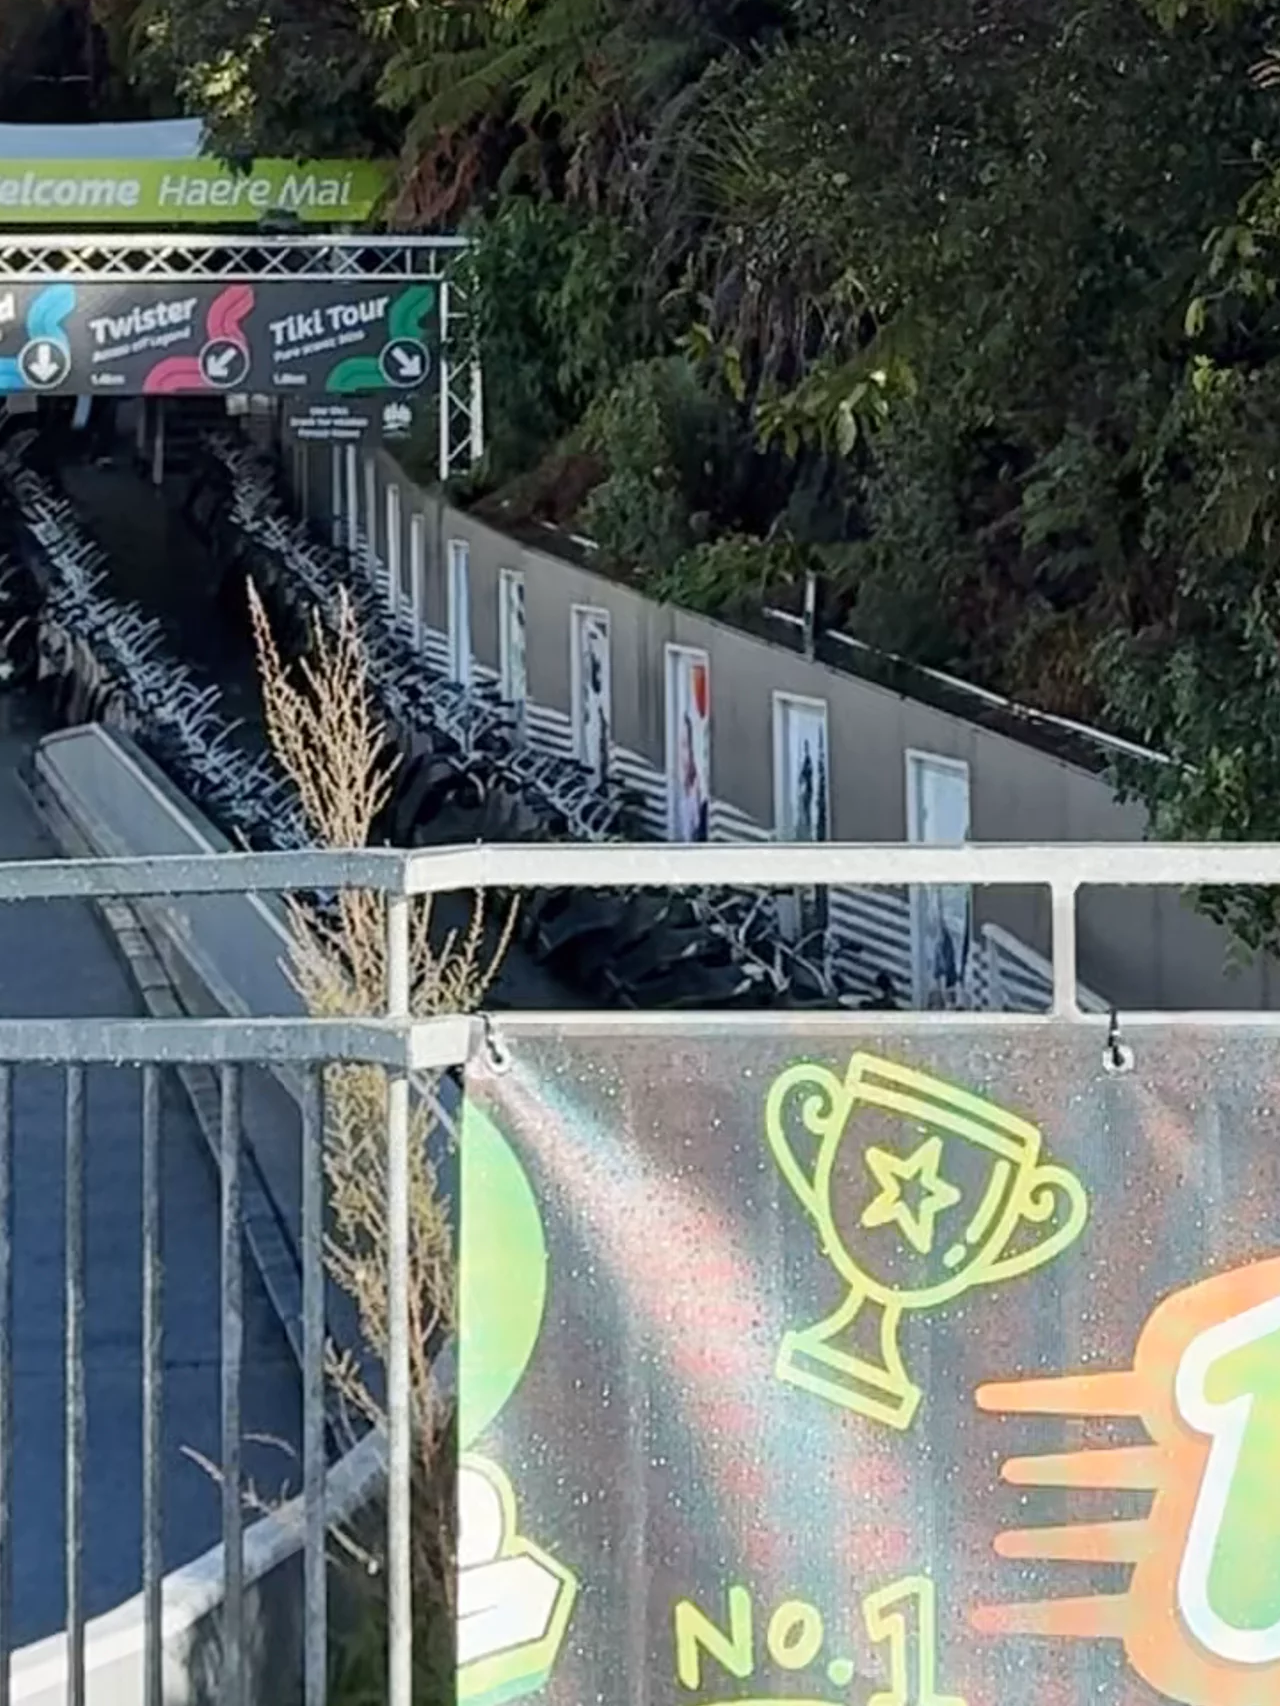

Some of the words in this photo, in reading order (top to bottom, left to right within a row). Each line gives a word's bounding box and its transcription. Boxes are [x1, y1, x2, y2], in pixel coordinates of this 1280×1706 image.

[158, 173, 270, 207] Haere
[278, 172, 353, 207] Mai
[89, 297, 198, 344] Twister
[270, 307, 323, 346] Tiki
[326, 296, 390, 335] Tour
